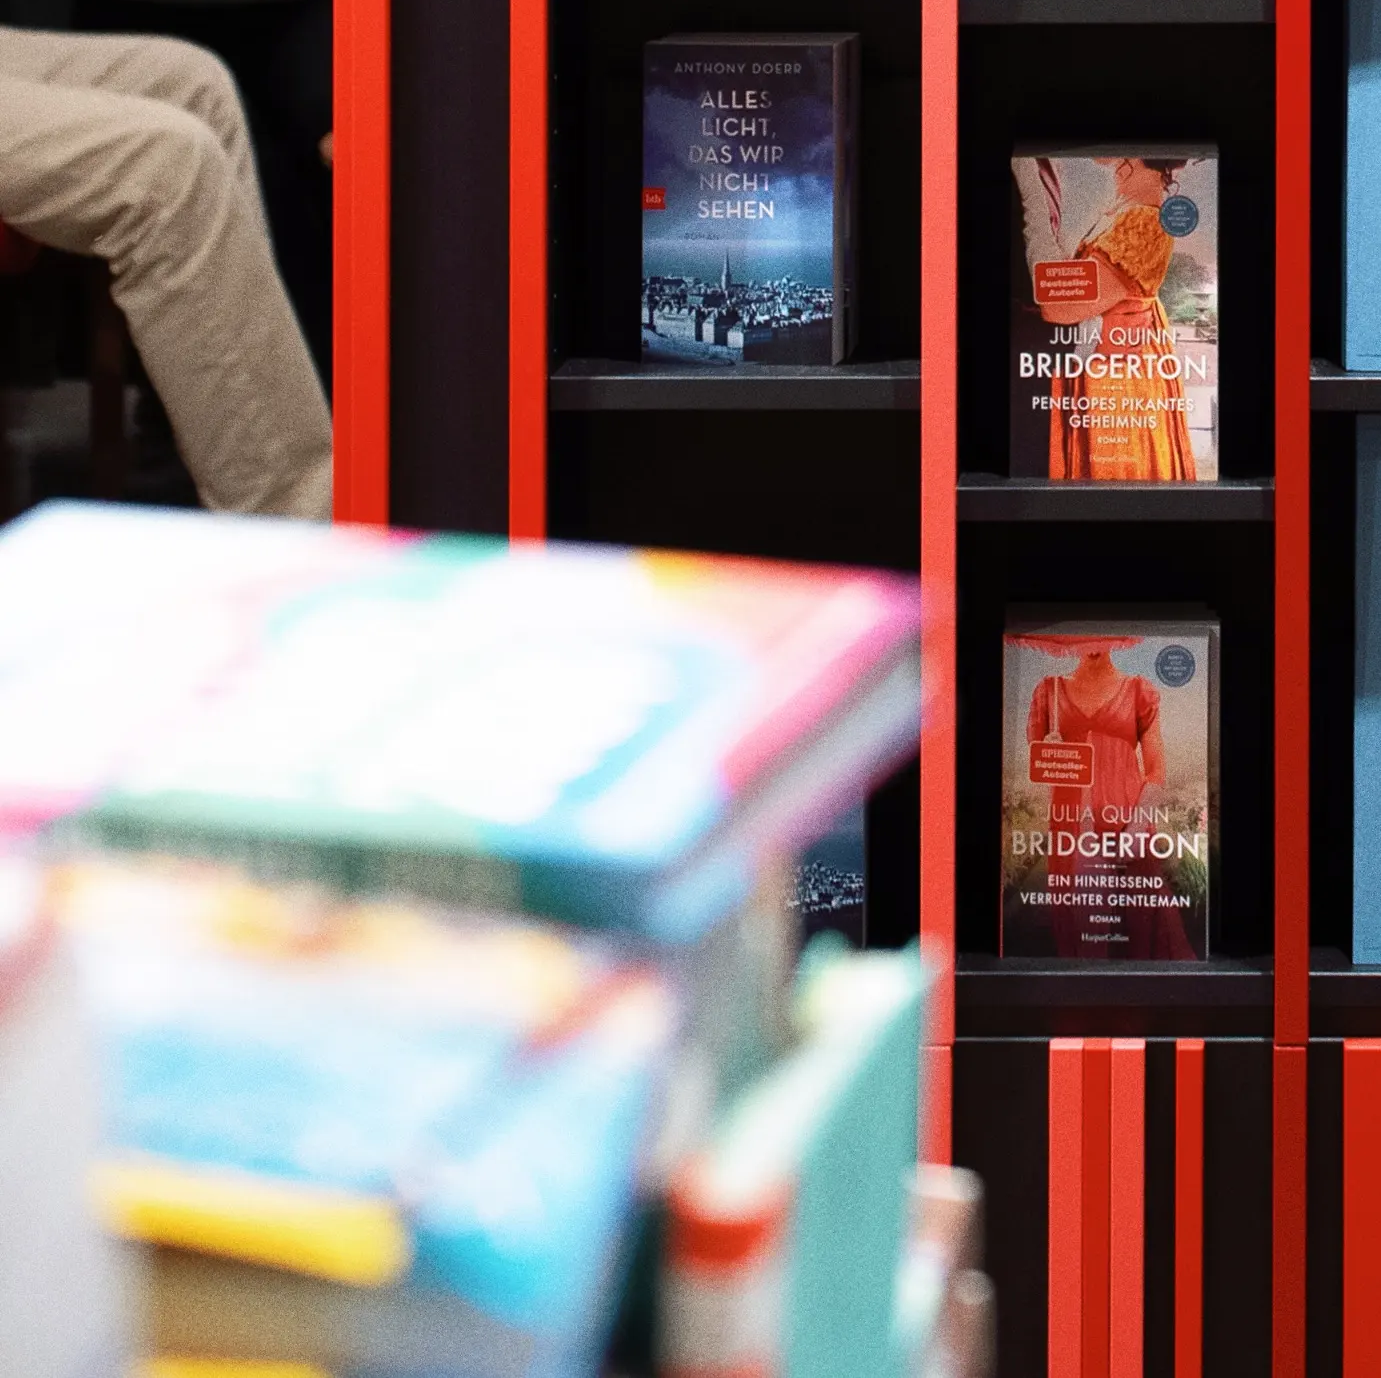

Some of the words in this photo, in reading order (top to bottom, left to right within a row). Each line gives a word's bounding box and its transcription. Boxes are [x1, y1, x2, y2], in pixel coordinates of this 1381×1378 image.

[674, 63, 745, 74] ANTHONY
[752, 63, 802, 74] DOERR
[701, 90, 772, 109] ALLES
[702, 118, 776, 138] LICHT,
[689, 146, 731, 163] DAS
[700, 173, 769, 192] NICHT
[698, 201, 774, 219] SEHEN
[1048, 288, 1085, 297] Autorin
[1049, 327, 1102, 345] JULIA
[1109, 327, 1176, 345] QUINN
[1019, 353, 1206, 380] BRIDGERTON
[1032, 397, 1116, 410] PENELOPES
[1122, 397, 1194, 411] PIKANTES
[1069, 415, 1157, 429] GEHEIMNIS
[1097, 436, 1128, 444] ROMAN
[1042, 771, 1079, 780] Autorin
[1042, 804, 1095, 823] JULIA
[1101, 805, 1168, 823] QUINN
[1012, 831, 1199, 859] BRIDGERTON
[1048, 875, 1070, 887] EIN
[1075, 875, 1163, 888] HINREISSEND
[1020, 892, 1103, 906] VERRUCHTER
[1108, 894, 1190, 908] GENTLEMAN
[1090, 915, 1121, 923] ROMAN
[1081, 933, 1129, 942] HarperCollins
